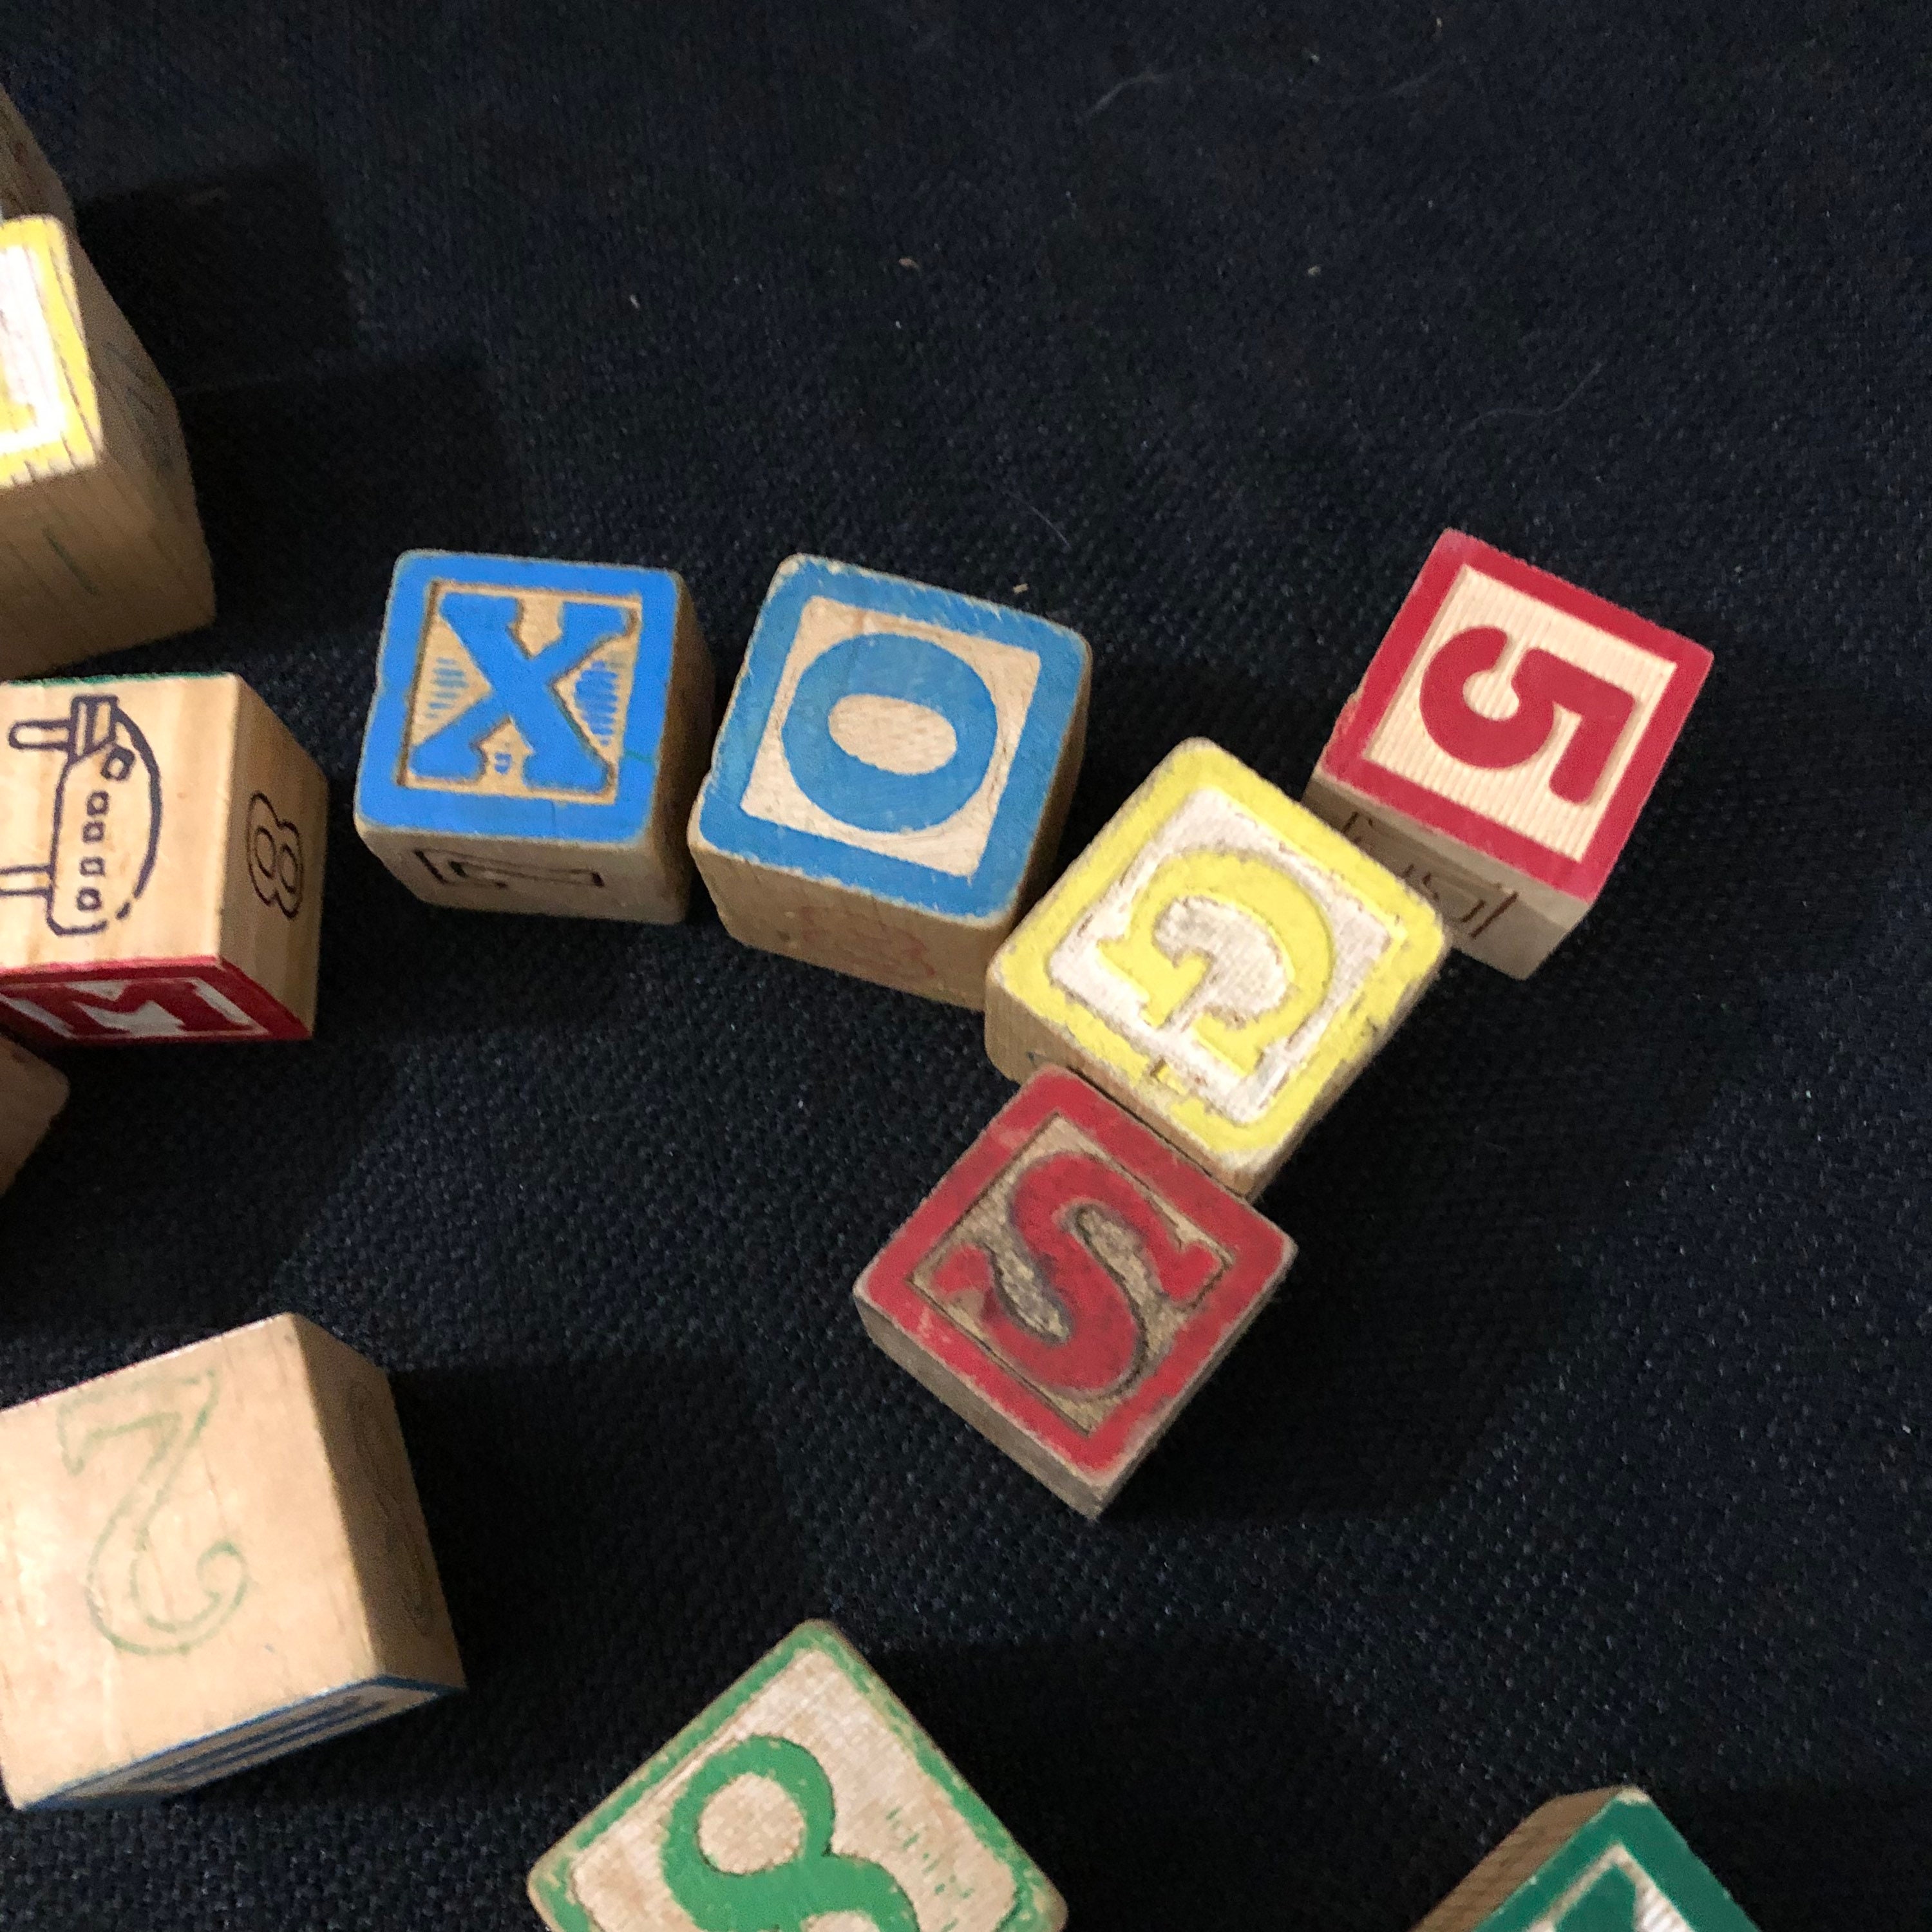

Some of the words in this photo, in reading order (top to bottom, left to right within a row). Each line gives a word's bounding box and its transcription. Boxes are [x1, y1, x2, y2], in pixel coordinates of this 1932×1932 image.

[410, 591, 628, 793] X
[781, 632, 998, 834] O
[1419, 625, 1636, 804] 5
[247, 792, 304, 920] 8
[0, 979, 256, 1036] M
[1097, 849, 1336, 1077] G
[931, 1153, 1220, 1392] S
[57, 1367, 249, 1656] 2
